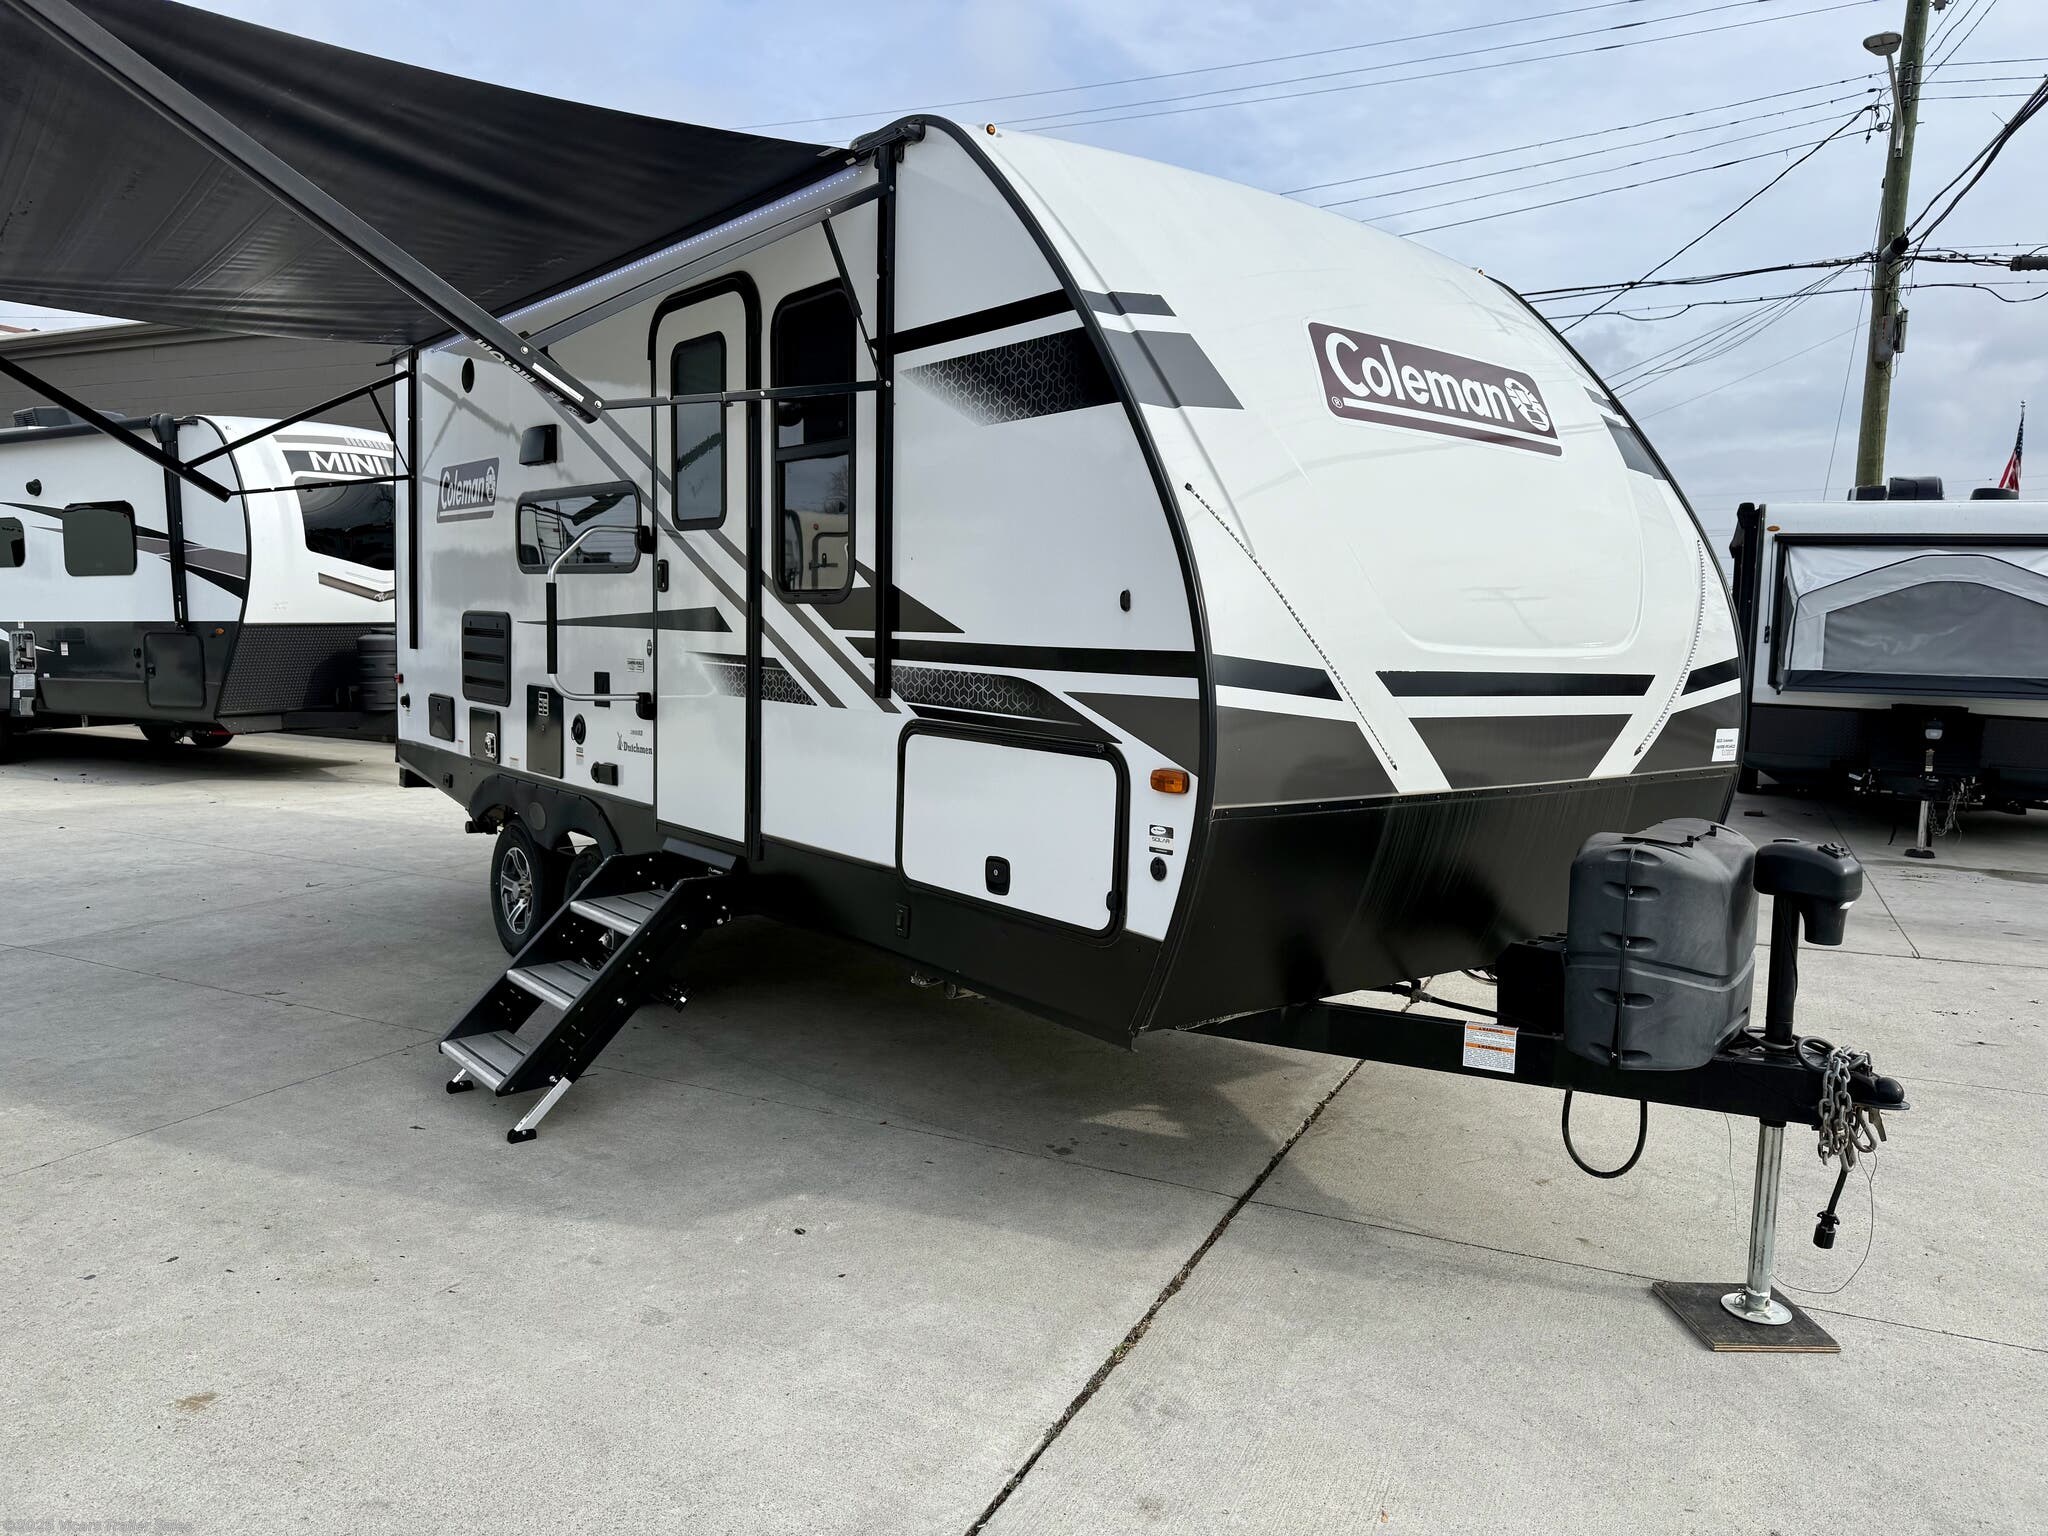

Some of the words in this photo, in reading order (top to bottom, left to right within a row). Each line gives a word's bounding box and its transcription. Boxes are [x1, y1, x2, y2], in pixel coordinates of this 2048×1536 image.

[1325, 332, 1515, 423] Coleman
[440, 469, 484, 510] Coleman
[623, 741, 653, 755] Dutchmen
